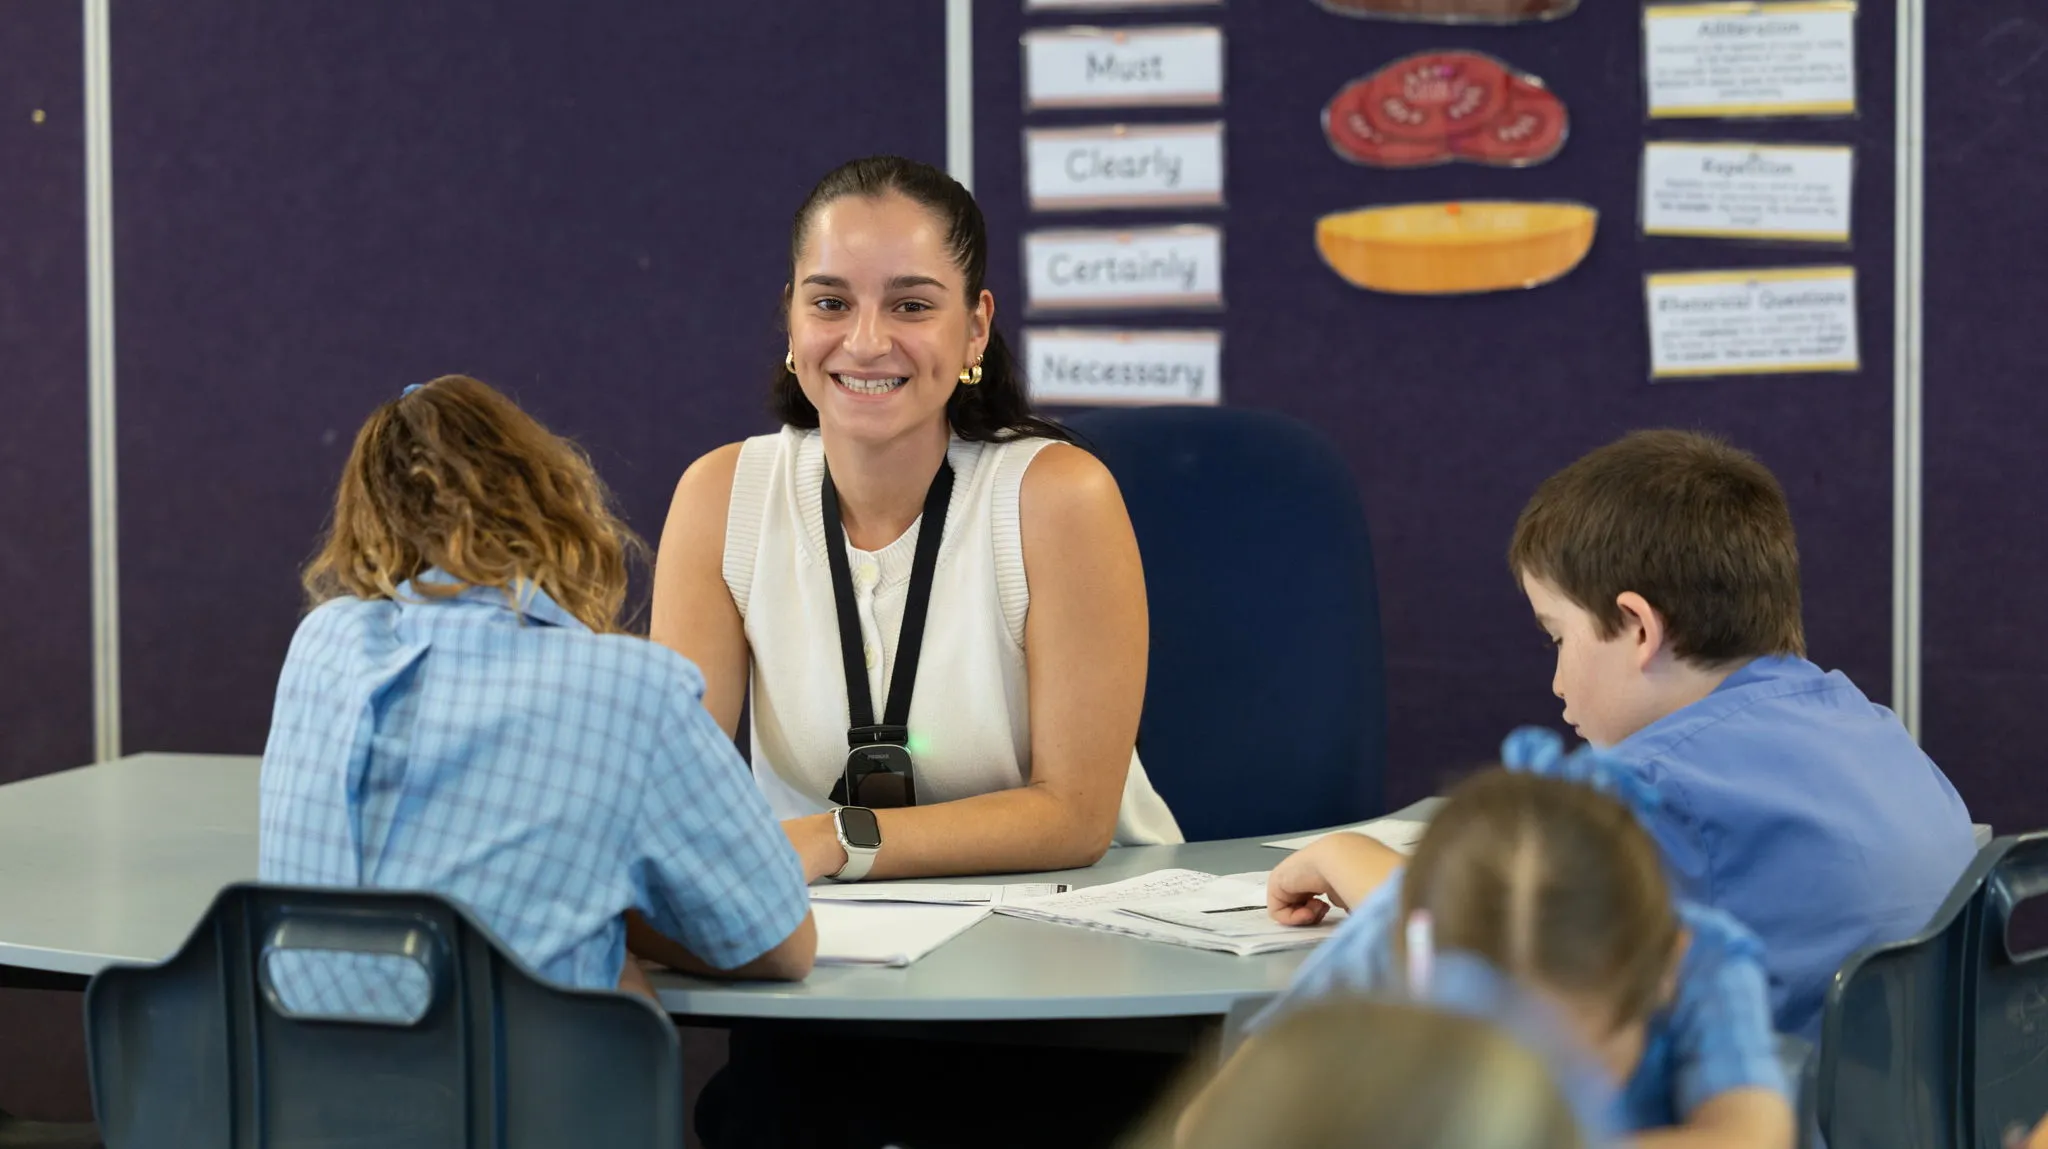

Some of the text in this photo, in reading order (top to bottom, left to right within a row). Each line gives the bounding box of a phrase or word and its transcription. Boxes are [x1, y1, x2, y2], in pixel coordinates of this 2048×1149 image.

[1086, 52, 1164, 82] Must
[1064, 147, 1183, 187] Clearly
[1047, 249, 1198, 290] Certainly
[1041, 354, 1205, 397] Necessary
